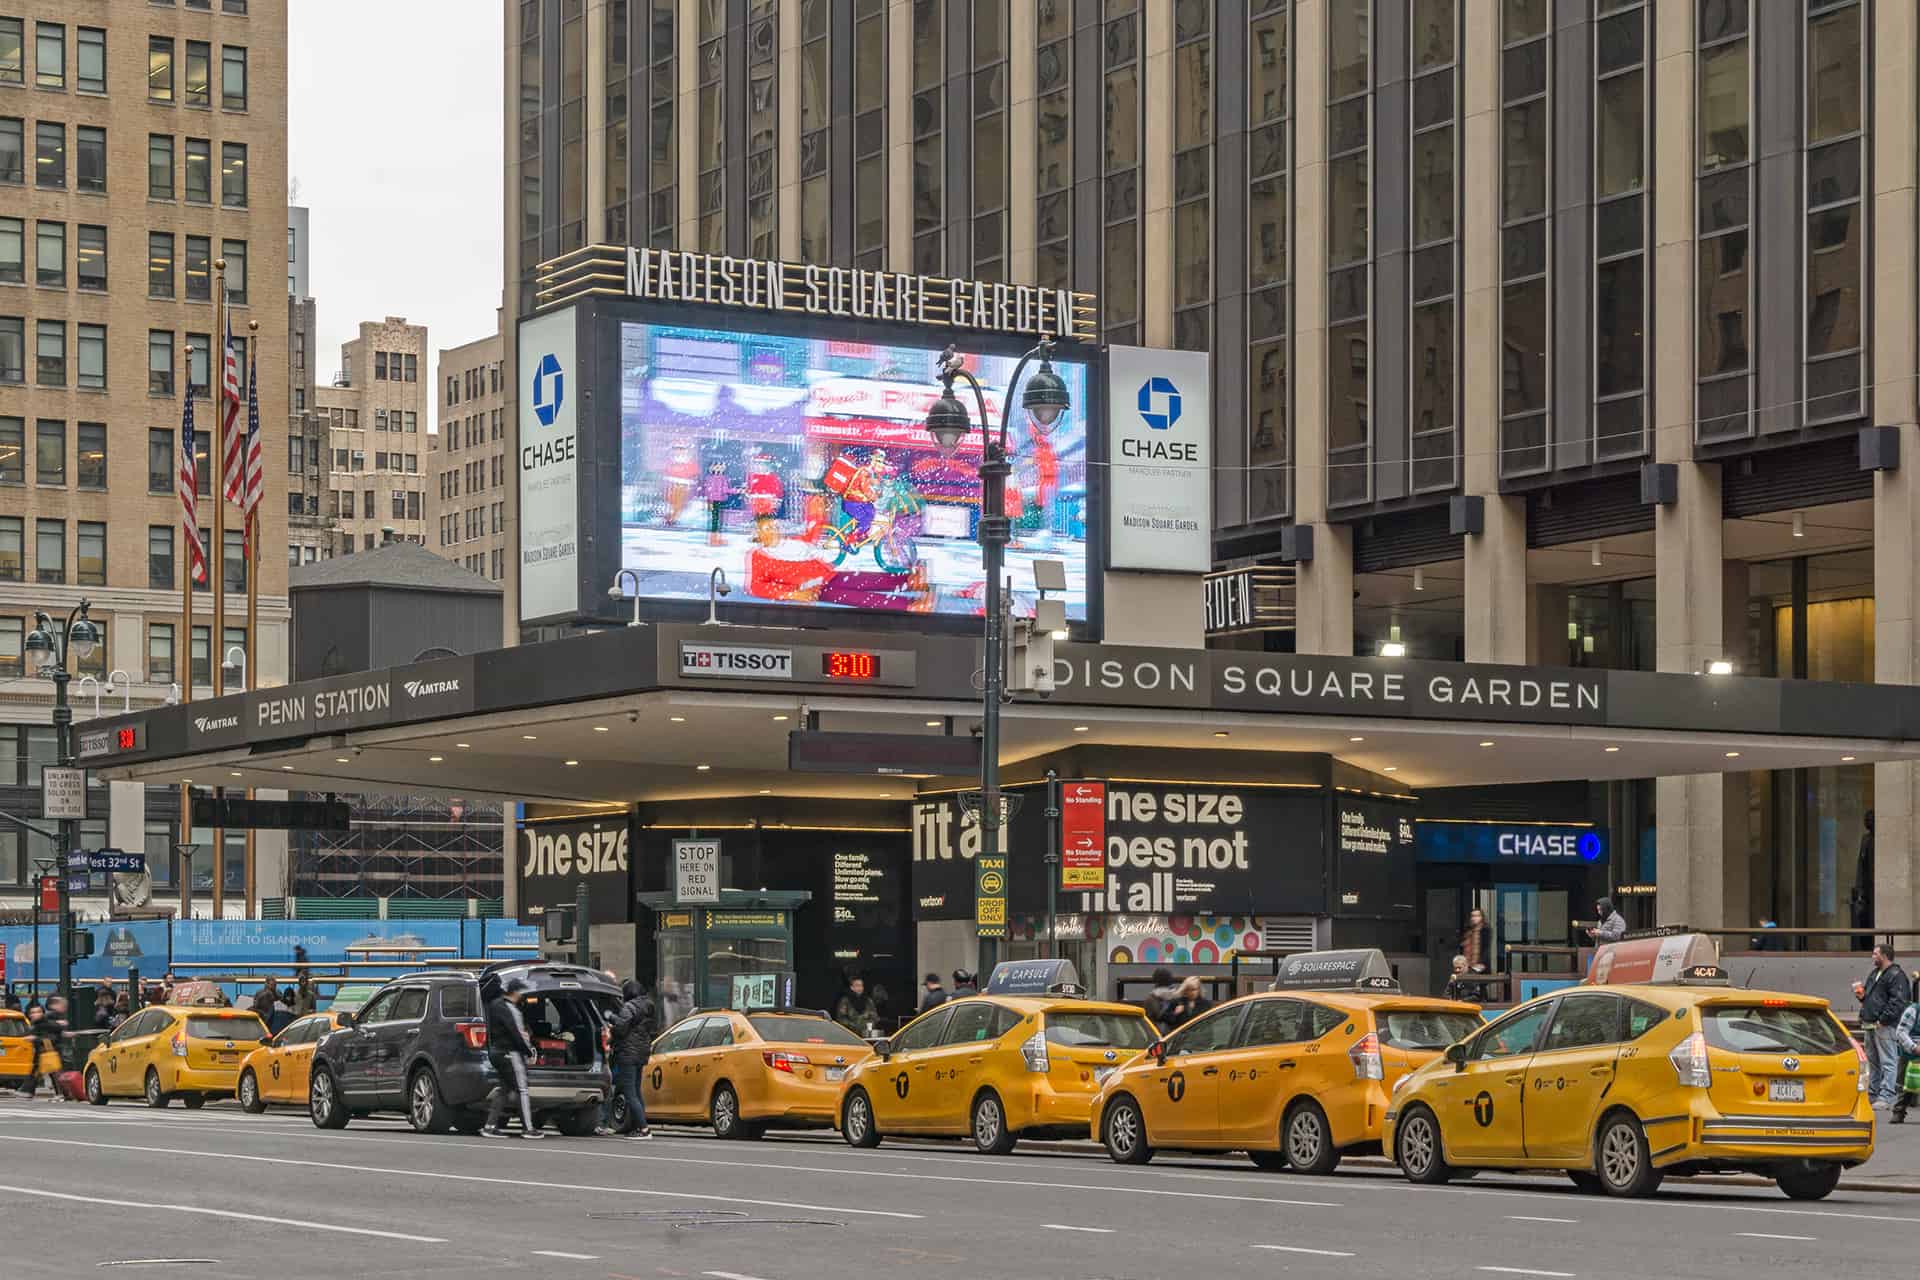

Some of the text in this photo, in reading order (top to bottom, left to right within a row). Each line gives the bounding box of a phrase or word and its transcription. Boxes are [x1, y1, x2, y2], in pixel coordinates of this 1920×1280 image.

[626, 247, 1073, 337] MADISON SQUARE GARDEN
[882, 389, 1001, 418] PIZA
[523, 435, 575, 470] CHASE
[1122, 439, 1198, 461] CHASE
[1123, 515, 1151, 528] MADISON
[1151, 517, 1175, 530] SQUARE
[524, 543, 575, 564] MADISON SQUARE GARDEN
[1204, 574, 1250, 630] RDEN
[714, 652, 790, 671] TISSOT
[831, 652, 872, 677] 3:10
[418, 680, 459, 697] AMTRAK
[1054, 658, 1600, 709] DISON SQUARE GARDEN
[258, 683, 390, 726] PENN STATION
[206, 717, 238, 731] AMTRAK
[1075, 797, 1102, 805] Standing
[1108, 791, 1243, 824] ne size
[912, 797, 1008, 861] fit al
[575, 823, 628, 873] size
[679, 847, 714, 860] STOP
[1108, 831, 1249, 869] oes not
[1499, 833, 1577, 856] CHASE
[90, 857, 140, 868] est 32nd St
[680, 863, 715, 872] HERE ON
[979, 859, 1005, 869] TAXI
[688, 874, 706, 884] RED
[680, 886, 714, 896] SIGNAL
[1127, 872, 1173, 912] all
[193, 935, 215, 945] FEEL
[247, 935, 260, 945] TO
[1011, 967, 1049, 981] CAPSULE
[1302, 960, 1357, 973] SQUARESPACE
[1693, 967, 1717, 977] 4C47
[1370, 979, 1390, 987] 4C42
